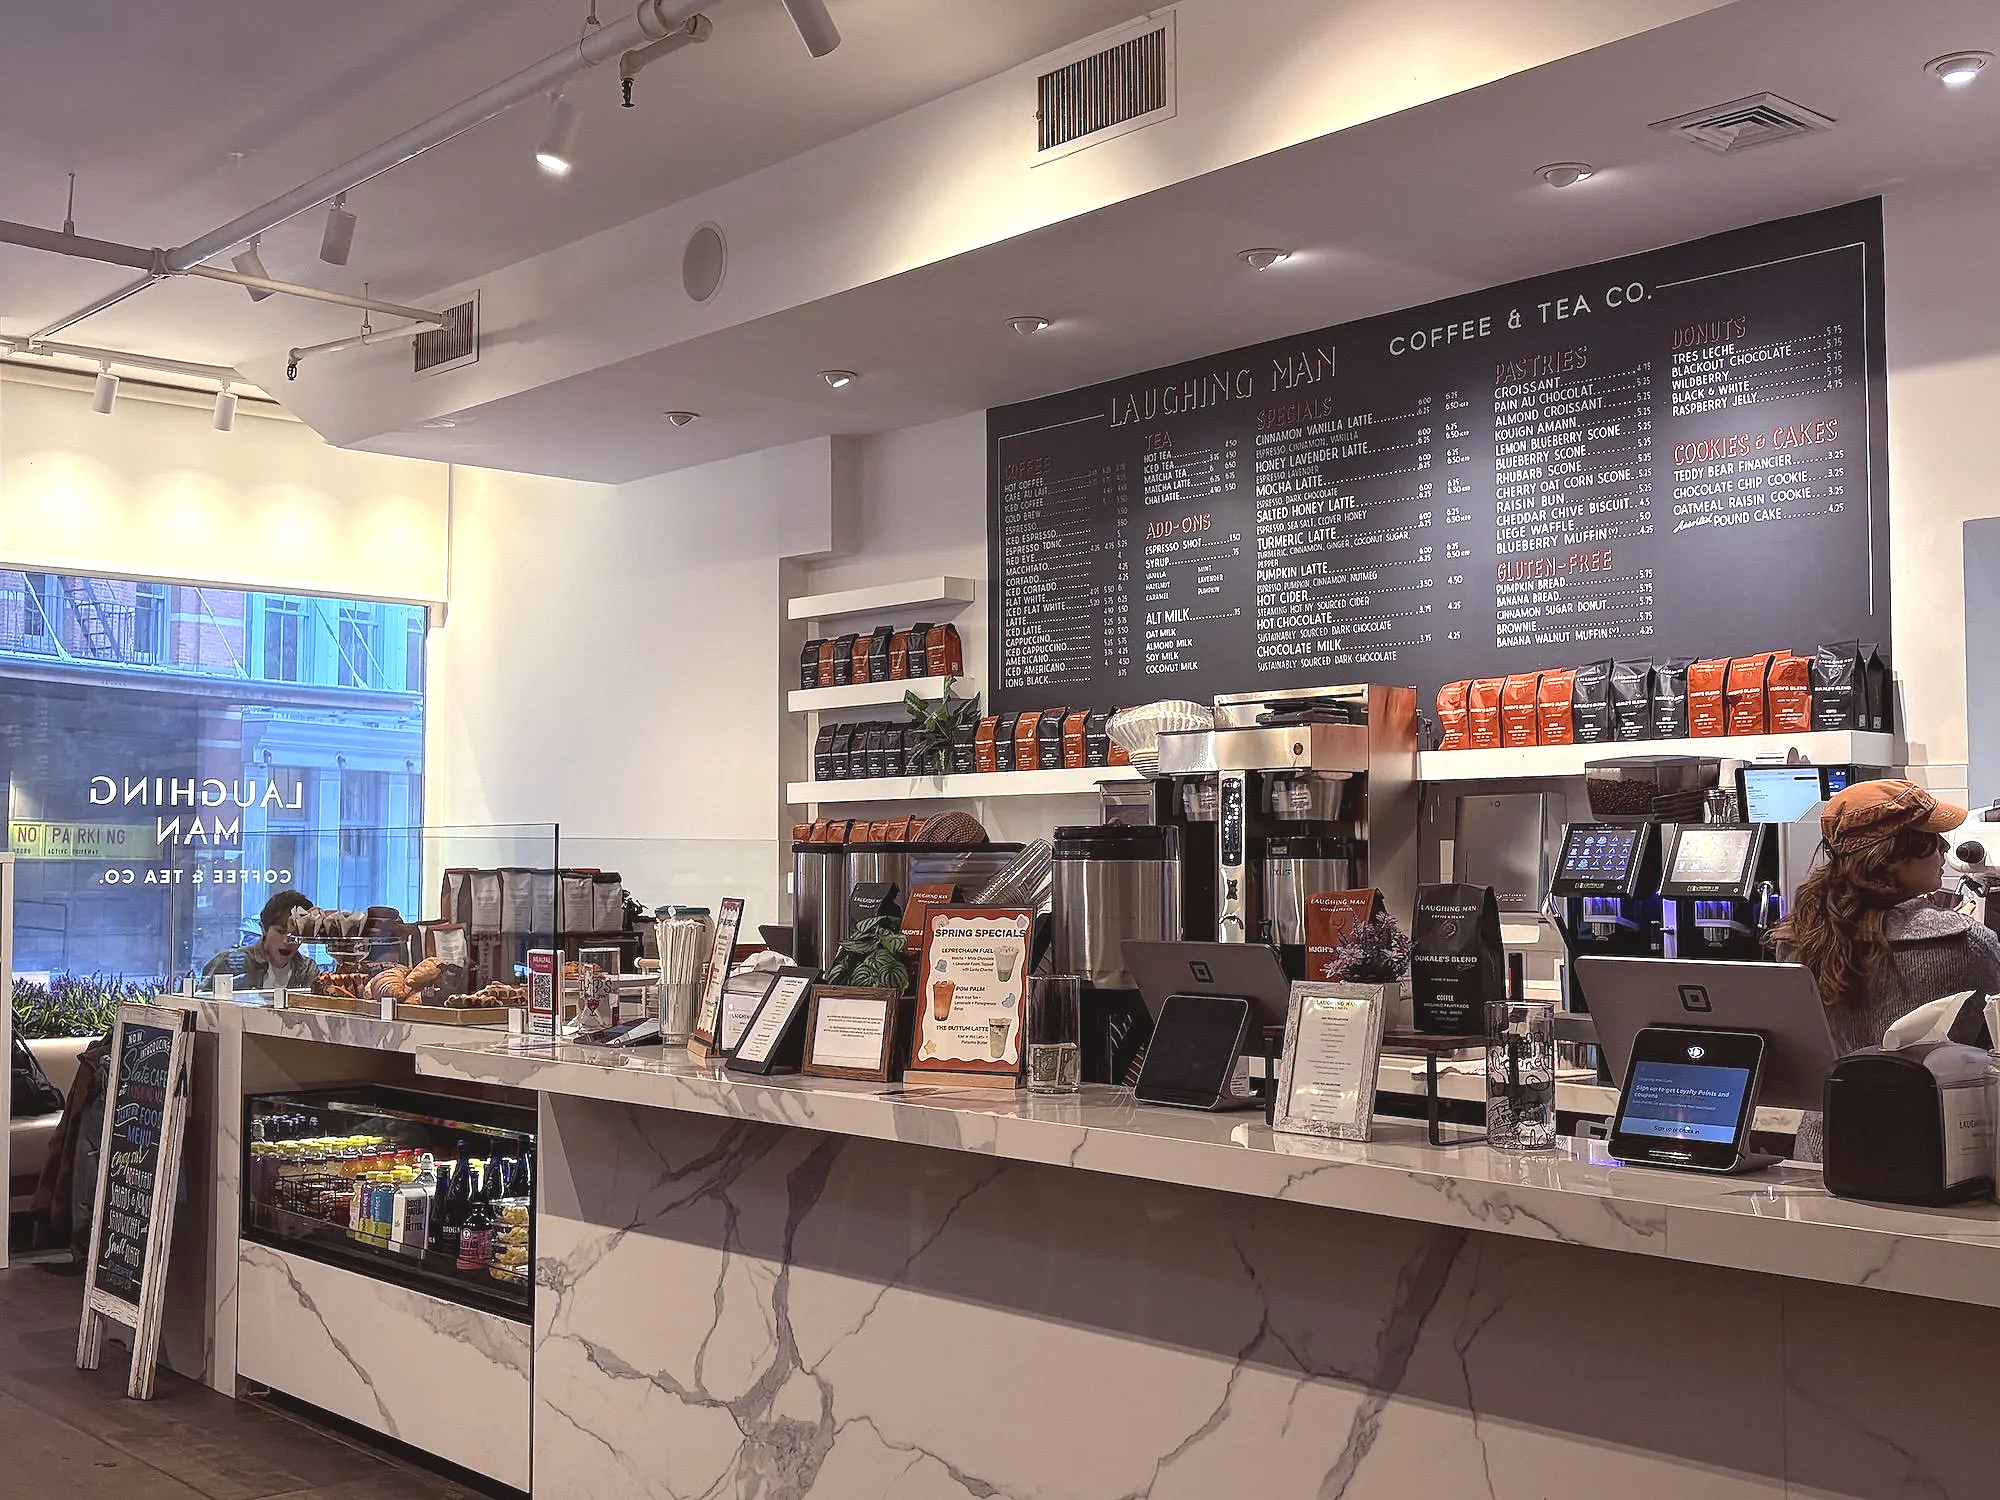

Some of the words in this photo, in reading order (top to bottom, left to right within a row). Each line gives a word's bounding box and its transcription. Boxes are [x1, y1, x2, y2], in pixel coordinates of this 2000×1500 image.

[1389, 320, 1491, 355] COFFEE
[1508, 310, 1522, 331] &
[1538, 295, 1591, 324] TEA
[1606, 282, 1653, 309] CO.
[1672, 316, 1746, 350] DONUTS
[1495, 346, 1588, 384] PASTRIES
[1672, 352, 1699, 365] TRES
[1702, 344, 1735, 360] LECHE
[1672, 359, 1724, 378] BLACKOUT
[1730, 346, 1792, 367] CHOCOLATE
[1109, 369, 1253, 428] LAUGHING
[1272, 346, 1337, 392] MAN
[1494, 377, 1561, 399] CROISSANT
[1672, 370, 1730, 390] WILDBERRY
[1494, 399, 1517, 412] PAIN
[1521, 395, 1535, 408] AU
[1539, 384, 1593, 404] CHOCOLAT
[1672, 389, 1704, 404] BLACK
[1708, 387, 1715, 396] &
[1718, 381, 1750, 396] WHITE
[1256, 397, 1332, 431] SPECIALS
[1495, 409, 1539, 427] ALMOND
[1544, 398, 1603, 417] CROISSANT
[1672, 399, 1728, 417] RASPBERRY
[1732, 392, 1758, 407] JELLY
[1256, 429, 1302, 446] CINNAMON
[1307, 419, 1343, 436] VANILLA
[1348, 413, 1374, 427] LATTE
[1495, 424, 1533, 441] KOUIGN
[1537, 417, 1577, 434] AMANN
[1495, 440, 1527, 457] LEMON
[1531, 431, 1582, 450] BLUEBERRY
[1588, 424, 1620, 440] SCONE
[1673, 434, 1750, 466] COOKIES
[1772, 419, 1839, 451] CAKES
[1256, 458, 1286, 473] HONEY
[1290, 447, 1338, 467] LAVENDER
[1342, 441, 1368, 457] LATTE
[1495, 450, 1549, 471] BLUEBERRY
[1555, 445, 1586, 461] SCONE
[1674, 468, 1704, 482] TEDDY
[1708, 463, 1734, 478] BEAR
[1739, 454, 1792, 473] FINANCIER
[1828, 450, 1844, 459] 3.25
[1496, 467, 1542, 485] RHUBARB
[1548, 461, 1582, 477] SCONE
[1496, 483, 1536, 500] CHERRY
[1540, 479, 1559, 493] OAT
[1564, 474, 1593, 489] CORN
[1598, 468, 1630, 484] SCONE
[1674, 482, 1733, 500] CHOCOLATE
[1738, 476, 1763, 490] CHIP
[1768, 470, 1808, 486] COOKIE
[1828, 468, 1844, 477] 3.25
[1144, 482, 1172, 495] MATCHA
[1174, 478, 1191, 489] LATTE
[1256, 481, 1292, 497] MOCHA
[1296, 475, 1323, 491] LATTE
[1256, 506, 1288, 524] SALTED
[1292, 502, 1324, 517] HONEY
[1328, 496, 1355, 511] LATTE
[1496, 497, 1534, 513] RAISIN
[1542, 493, 1565, 507] BUN
[1496, 510, 1546, 526] CHEDDAR
[1552, 505, 1583, 519] CHIVE
[1589, 497, 1629, 514] BISCUIT
[1673, 499, 1724, 516] OATMEAL
[1728, 494, 1765, 508] RAISIN
[1771, 487, 1811, 503] COOKIE
[1828, 486, 1844, 496] 3.25
[1145, 513, 1212, 540] ADD-ONS
[1713, 511, 1750, 527] POUND
[1754, 507, 1782, 522] CAKE
[1829, 503, 1845, 513] 4.25
[1257, 532, 1304, 550] TURMERIC
[1308, 527, 1337, 542] LATTE
[1496, 527, 1525, 541] LIEGE
[1531, 520, 1574, 535] WAFFLE
[1496, 536, 1558, 554] BLUEBERRY
[1564, 528, 1607, 545] MUFFIN
[1145, 540, 1180, 555] ESPRESSO
[1183, 537, 1202, 549] SHOT
[1145, 557, 1170, 569] SYRUP
[1257, 566, 1297, 582] PUMPKIN
[1301, 561, 1328, 576] LATTE
[1497, 550, 1612, 582] GLUTEN-FREE
[1496, 580, 1534, 595] PUMPKIN
[1538, 577, 1566, 590] BREAD
[1257, 593, 1276, 607] HOT
[1280, 590, 1309, 603] CIDER
[1496, 595, 1529, 608] BANANA
[1533, 591, 1559, 604] BREAD
[1497, 606, 1541, 620] CINNAMON
[1545, 602, 1573, 616] SUGAR
[1578, 600, 1607, 612] DONUT
[1145, 612, 1162, 625] ALT
[1165, 608, 1189, 623] MILK
[1257, 617, 1275, 630] HOT
[1277, 611, 1332, 628] CHOCOLATE
[1496, 621, 1536, 635] BROWNIE
[1005, 634, 1050, 647] CAPPUCCINO
[1145, 641, 1174, 651] ALMOND
[1176, 638, 1193, 648] MILK
[1257, 642, 1311, 658] CHOCOLATE
[1317, 639, 1342, 651] MILK
[1496, 636, 1531, 648] BANANA
[1535, 631, 1570, 644] WALNUT
[1576, 628, 1608, 641] MUFFIN
[1145, 663, 1179, 674] COCONUT
[1181, 661, 1198, 671] MILK
[1005, 677, 1022, 687] LONG
[1025, 675, 1049, 686] BLACK
[17, 827, 37, 843] NO
[51, 827, 125, 844] PARKING
[935, 929, 973, 938] SPRING
[975, 929, 1026, 937] SPECIALS
